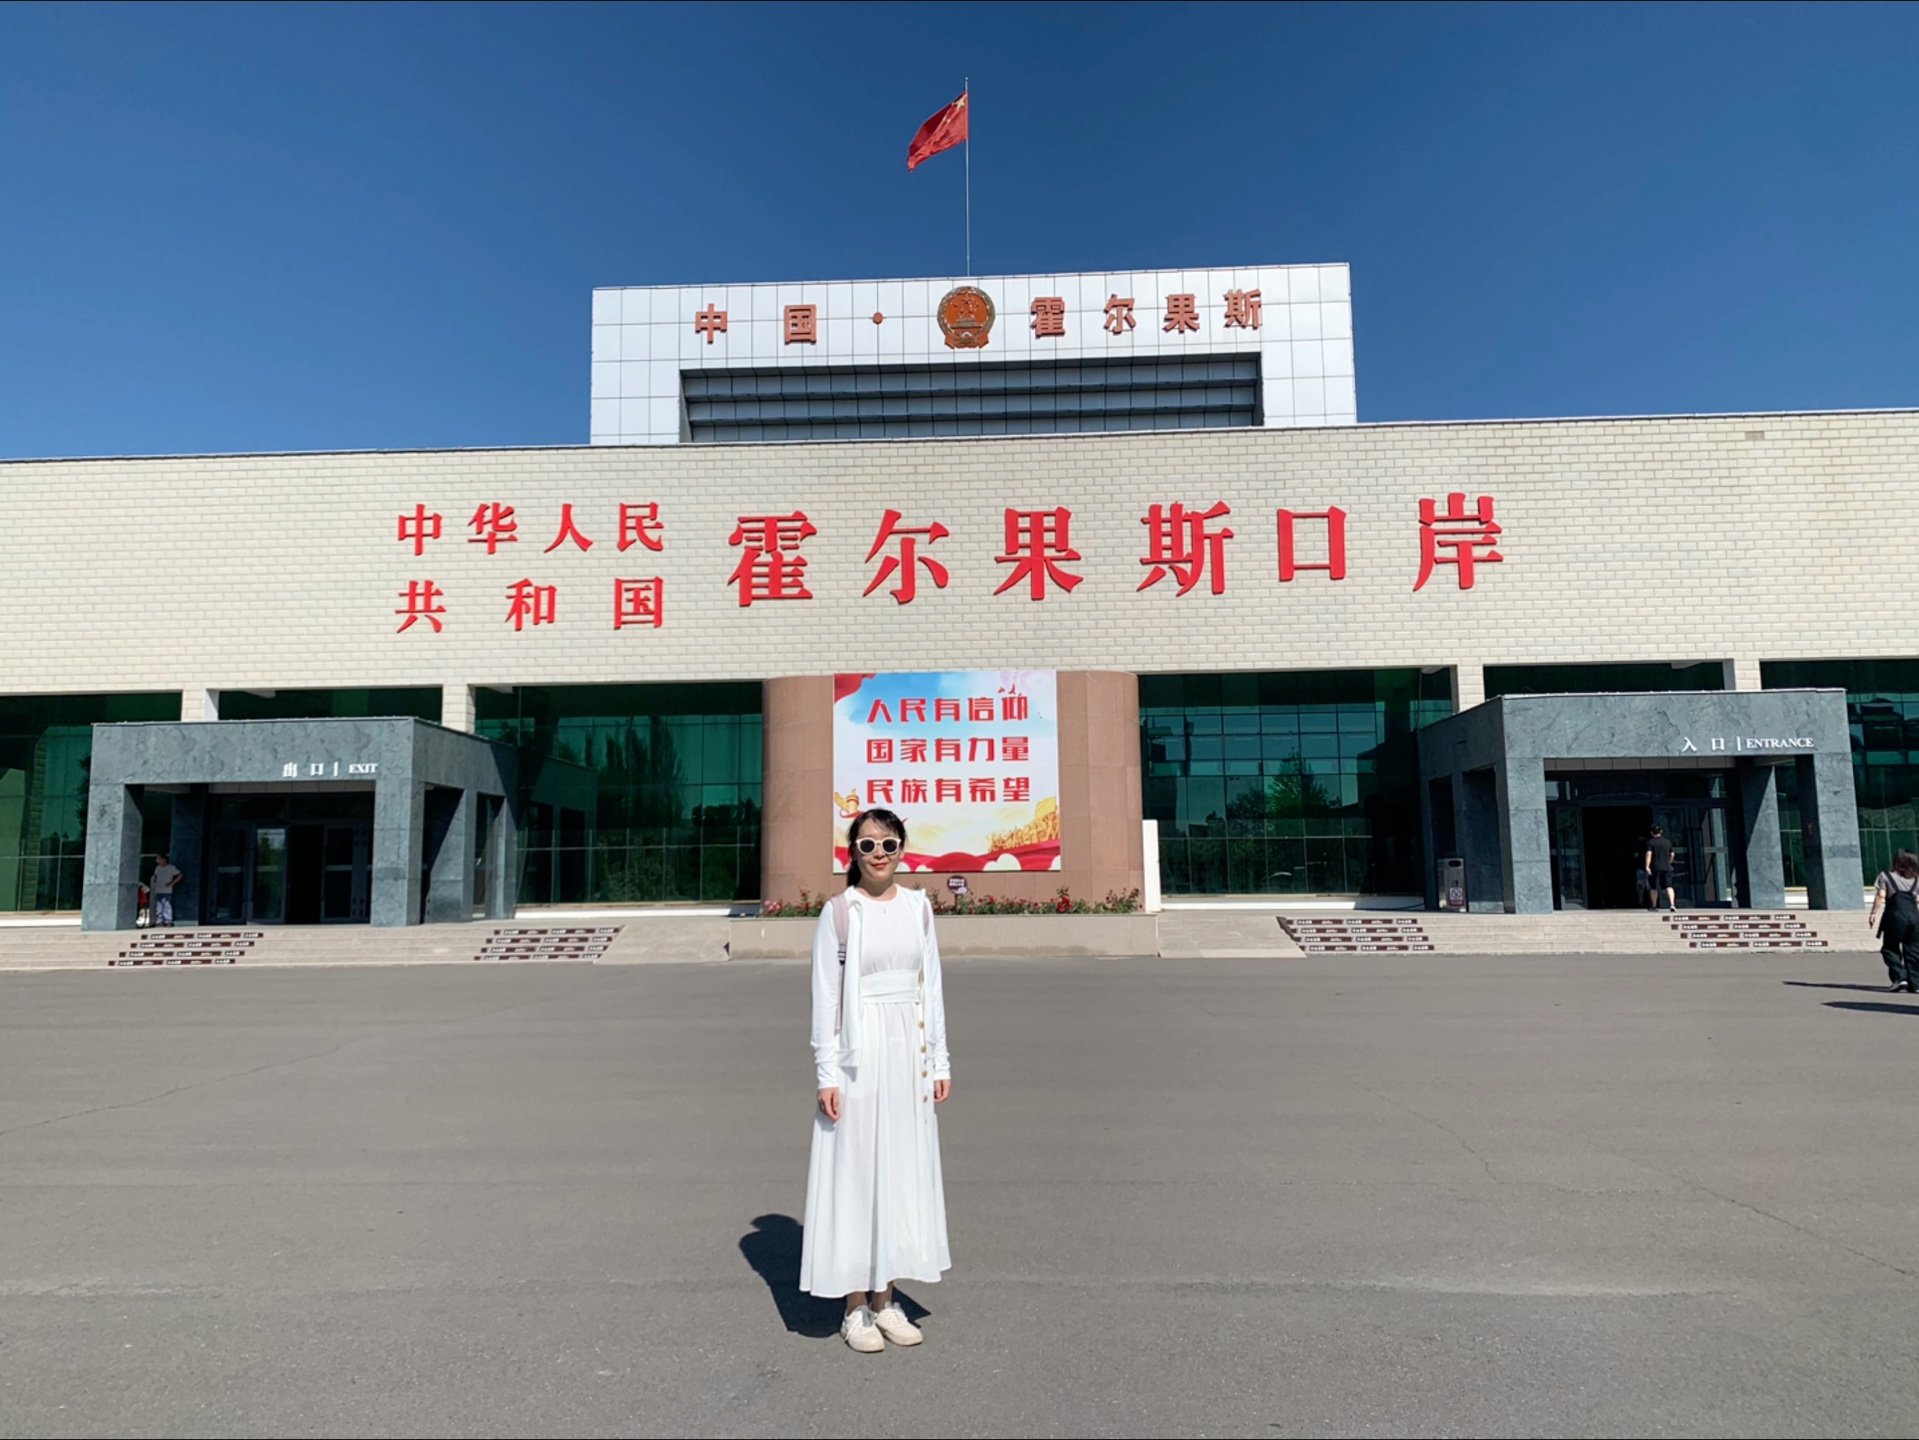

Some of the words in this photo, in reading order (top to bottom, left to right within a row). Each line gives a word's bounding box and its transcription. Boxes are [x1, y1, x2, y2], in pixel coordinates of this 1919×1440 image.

[1030, 288, 1263, 337] 霍尔果斯
[398, 501, 665, 557] 中华人民
[727, 491, 1505, 607] 霍尔果斯口岸
[395, 575, 665, 634] 共和国
[866, 694, 1029, 724] 人民有信仰
[866, 736, 1030, 765] 国家有力量
[1681, 736, 1726, 753] 入口
[1745, 737, 1815, 750] ENTRANCE
[282, 761, 325, 779] 出口
[348, 762, 379, 775] EXIT
[866, 776, 1031, 805] 民族有希望
